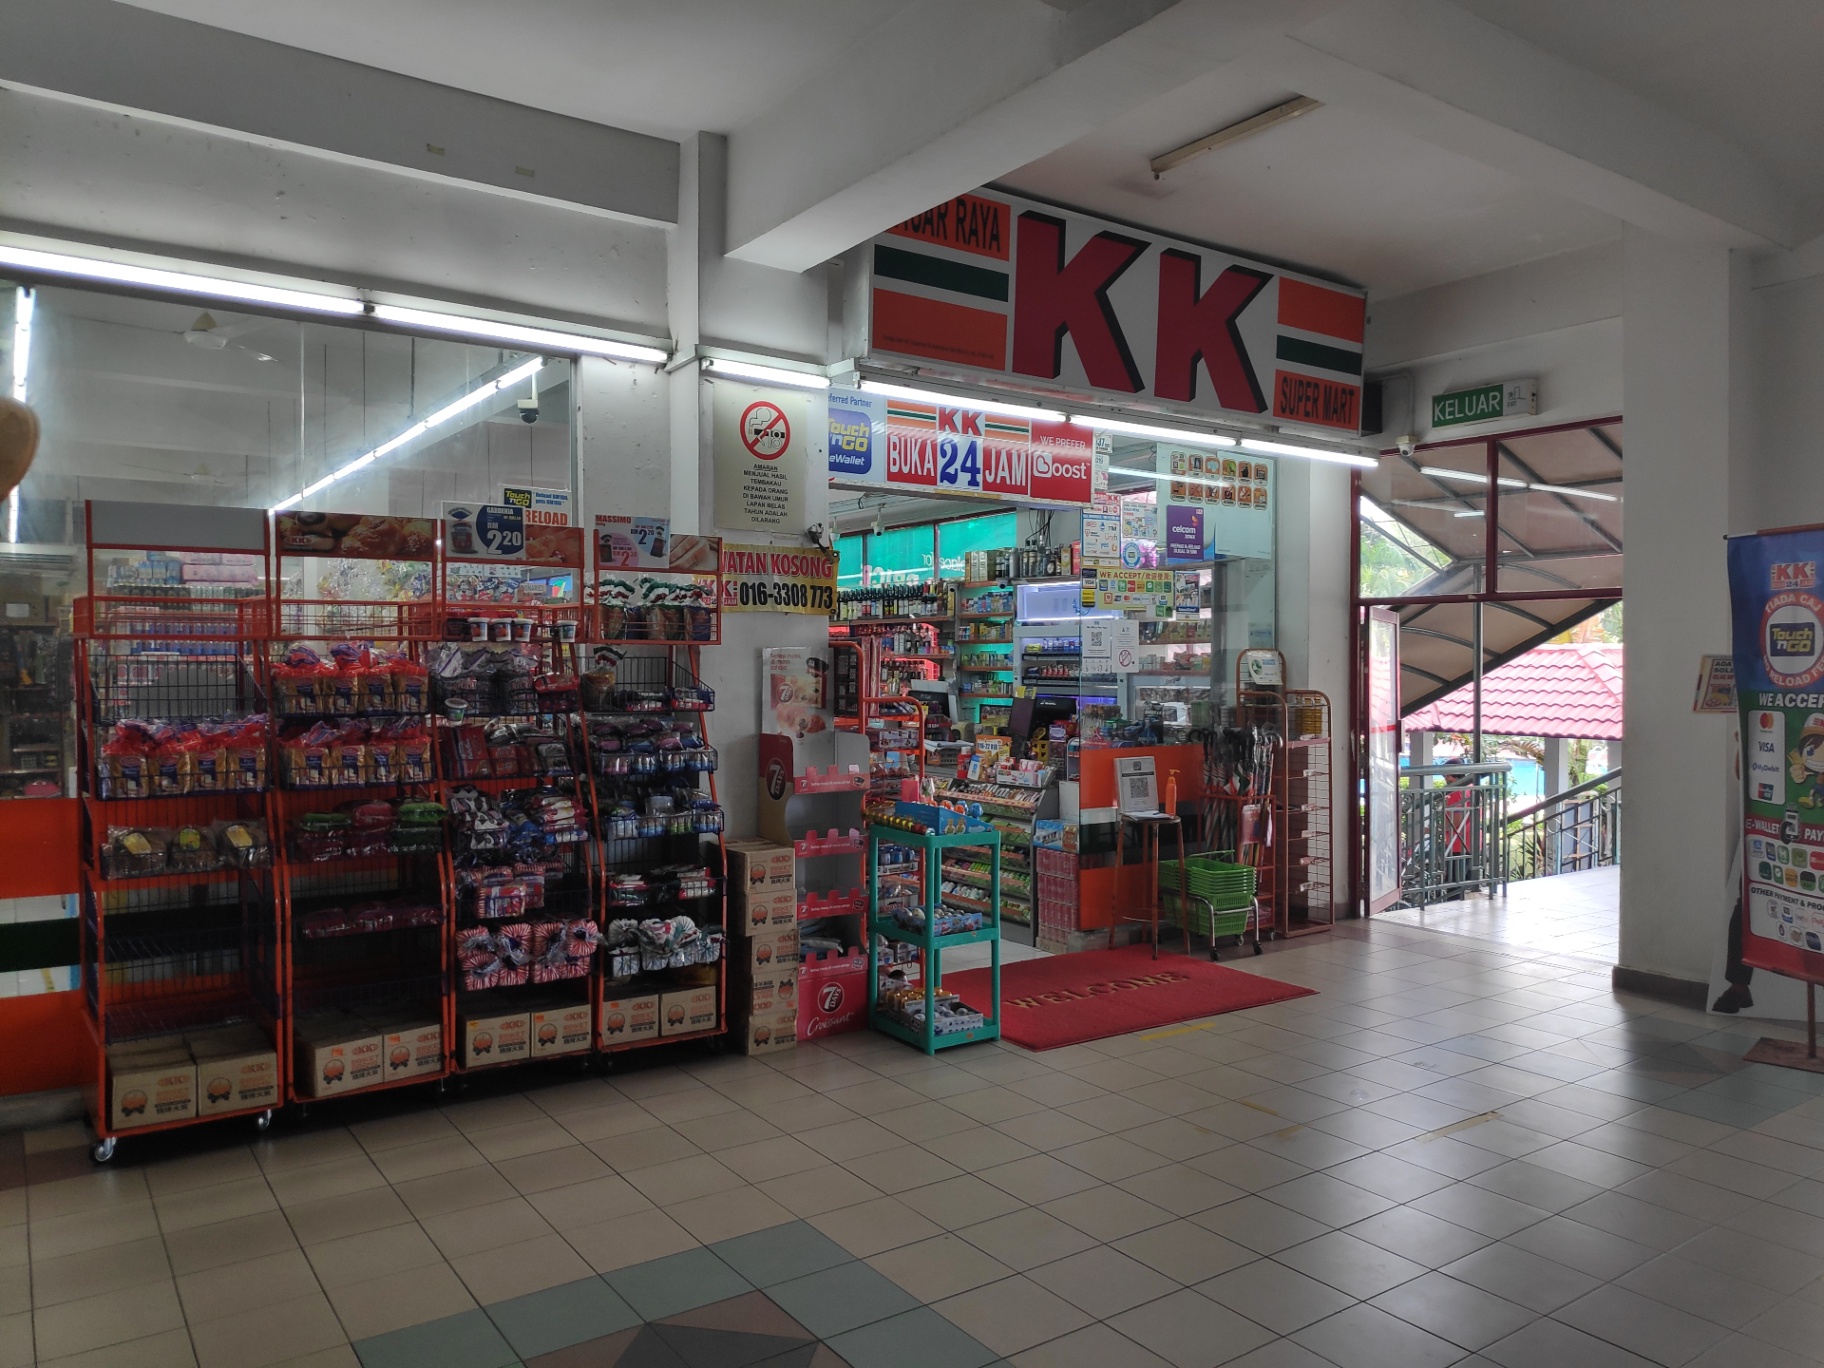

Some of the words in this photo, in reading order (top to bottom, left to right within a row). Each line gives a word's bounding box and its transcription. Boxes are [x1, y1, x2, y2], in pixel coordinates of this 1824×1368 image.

[955, 197, 1001, 253] RAYA
[1012, 210, 1274, 414] KK
[829, 393, 849, 404] ferred
[850, 396, 873, 408] Partner
[1280, 375, 1319, 419] SUPER
[1322, 383, 1355, 425] MART
[1434, 391, 1500, 422] KELUAR
[938, 406, 982, 436] KK
[1039, 434, 1054, 447] WE
[1055, 437, 1086, 450] PREFER
[753, 463, 779, 472] AMARAN
[829, 453, 866, 466] eWallet
[889, 434, 935, 477] BUKA
[939, 438, 981, 487] 24
[985, 448, 1027, 487] JAM
[743, 469, 770, 478] MENJUAL
[771, 473, 788, 481] HASIL
[750, 478, 782, 487] TEMBAKAU
[505, 490, 531, 499] Touch
[743, 485, 767, 493] KEPADA
[767, 487, 789, 495] ORANG
[750, 493, 771, 501] BAWAH
[486, 506, 514, 515] GARDENIA
[525, 509, 568, 526] RELOAD
[743, 507, 764, 515] TAHUN
[595, 514, 632, 524] MASSIMO
[751, 516, 781, 524] DILARANG
[1172, 524, 1196, 534] celcom
[770, 553, 833, 579] KOSONG
[1776, 562, 1809, 581] KK
[1785, 580, 1799, 588] 24
[740, 581, 808, 608] 016-3308
[809, 584, 833, 609] 773
[1765, 593, 1796, 614] TIADA
[1800, 594, 1822, 612] CAJ
[1772, 627, 1813, 640] Touch
[1769, 670, 1811, 687] RELOAD
[1759, 692, 1774, 706] WE
[1758, 741, 1775, 753] VISA
[1745, 818, 1780, 834] E-WALLET
[1751, 887, 1774, 897] OTHER
[1774, 891, 1799, 905] PAYMENT
[822, 986, 837, 1010] 7
[830, 987, 842, 1008] DAYS
[1006, 971, 1190, 1009] WELCOME
[807, 1011, 855, 1037] Croissant
